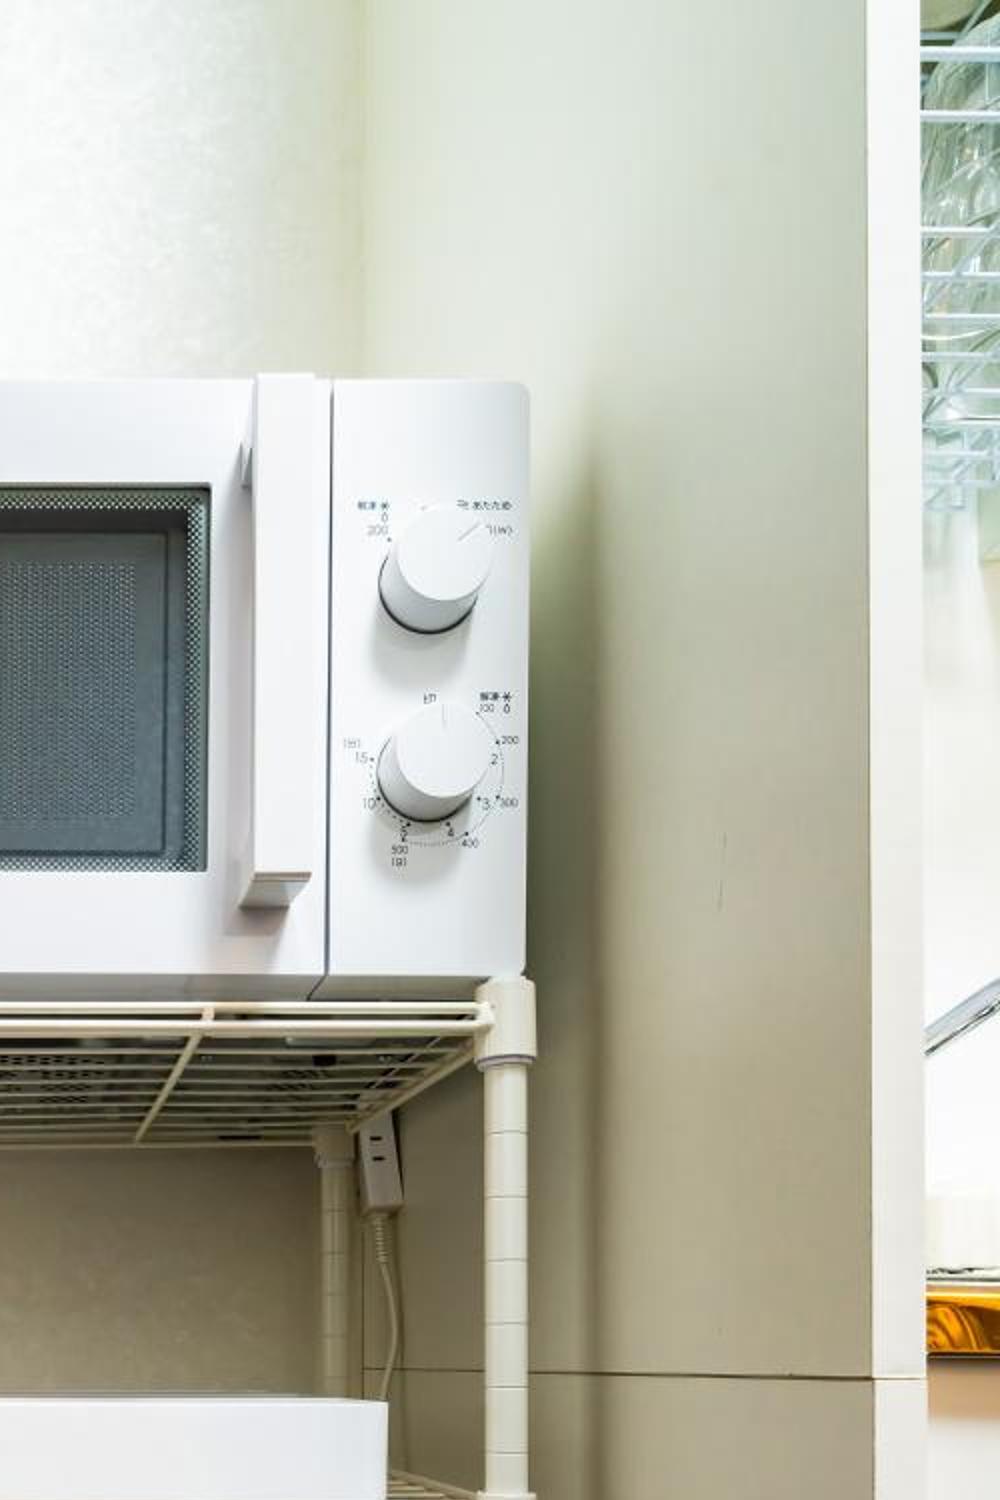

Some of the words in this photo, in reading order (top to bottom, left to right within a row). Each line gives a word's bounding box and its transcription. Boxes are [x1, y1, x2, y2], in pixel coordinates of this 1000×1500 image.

[491, 754, 499, 765] 2
[363, 798, 376, 810] 10
[482, 798, 491, 811] 3
